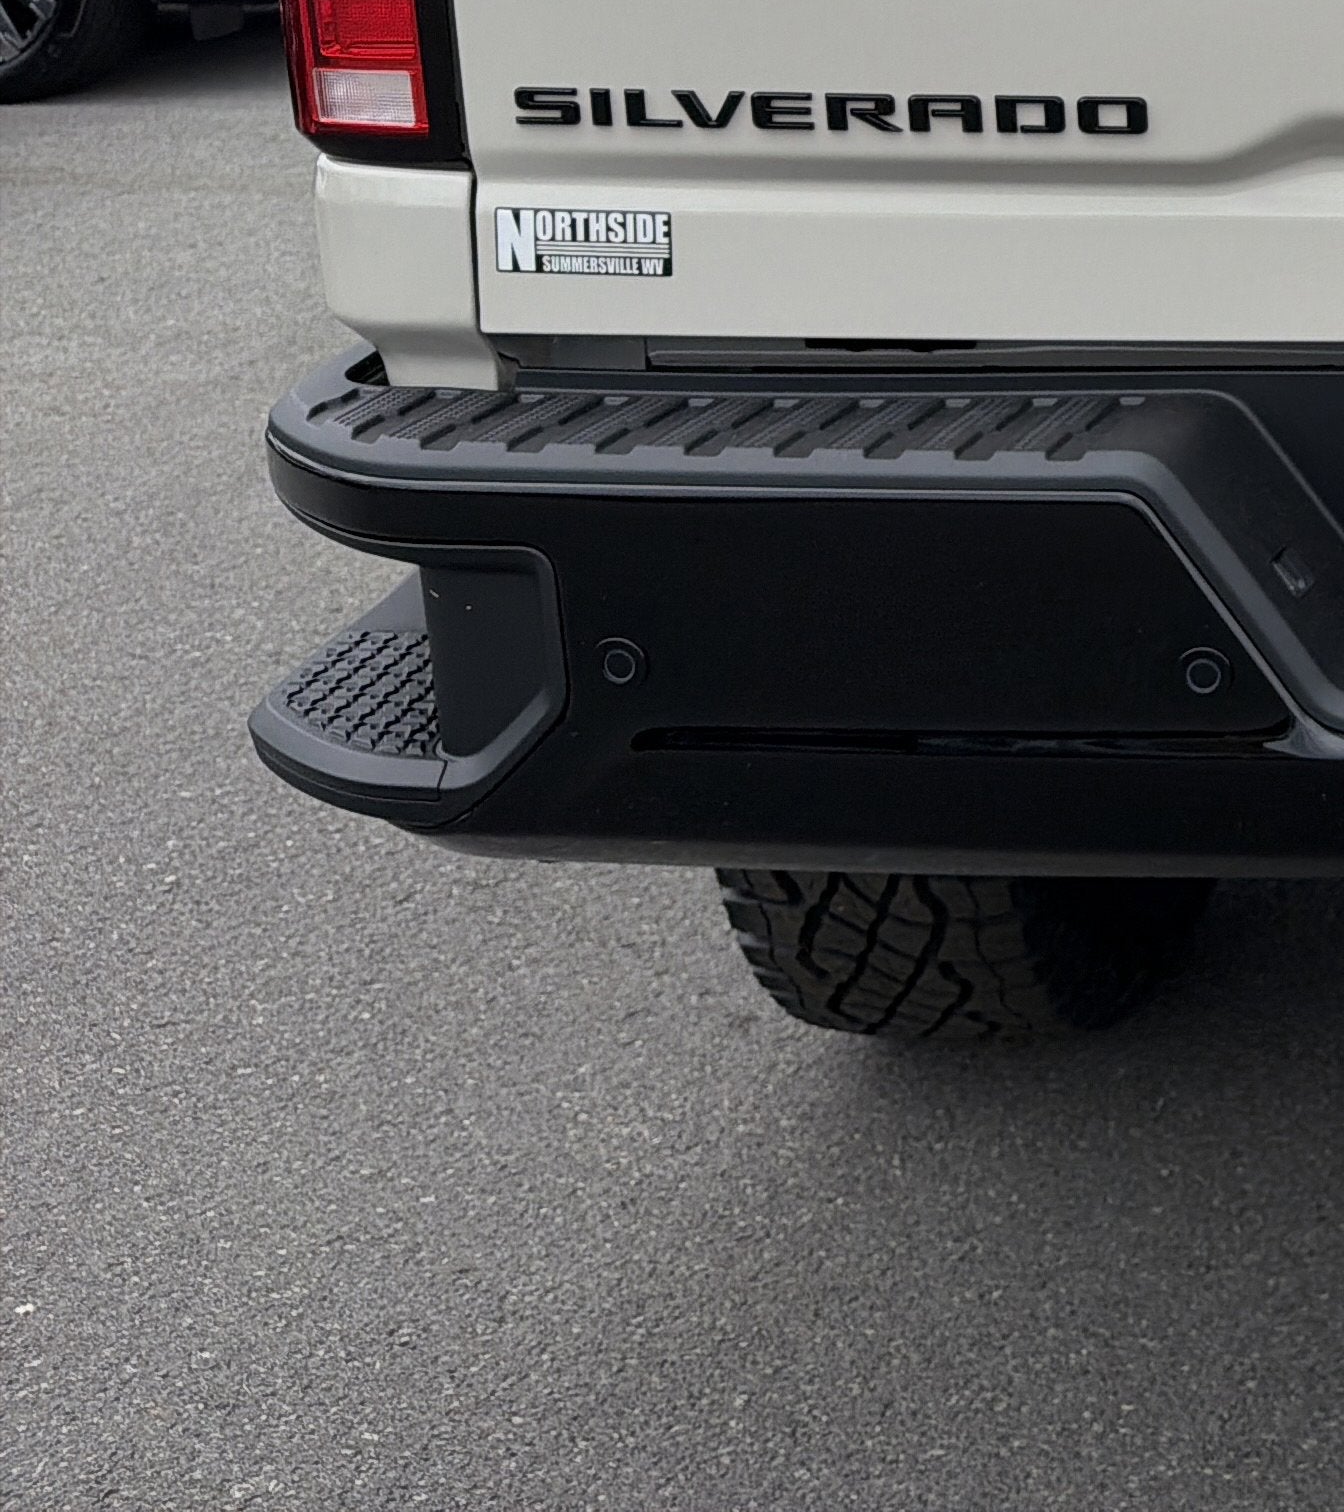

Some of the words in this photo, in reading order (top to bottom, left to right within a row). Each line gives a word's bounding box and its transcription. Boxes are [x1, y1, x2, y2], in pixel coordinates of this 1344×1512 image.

[514, 86, 1149, 135] SILVERADO
[496, 208, 670, 271] NORTHSIDE
[542, 255, 639, 274] SUMMERSVILLE
[640, 258, 664, 275] WV
